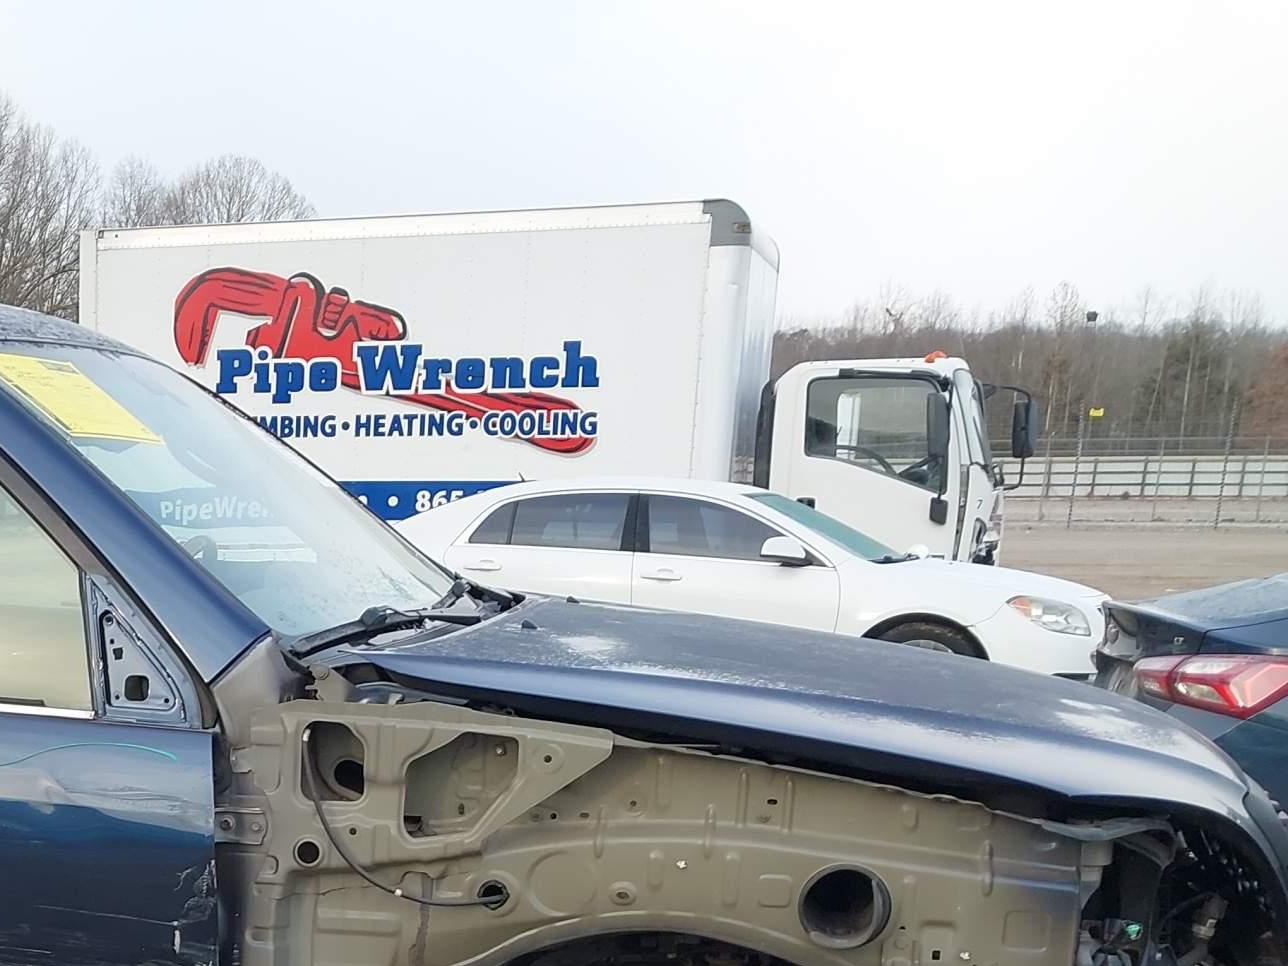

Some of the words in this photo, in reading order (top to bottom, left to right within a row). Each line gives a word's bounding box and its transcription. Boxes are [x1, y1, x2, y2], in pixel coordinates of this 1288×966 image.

[216, 348, 337, 404] Pipe
[357, 341, 600, 391] Wrench
[354, 413, 464, 437] HEATING
[483, 411, 598, 436] COOLING
